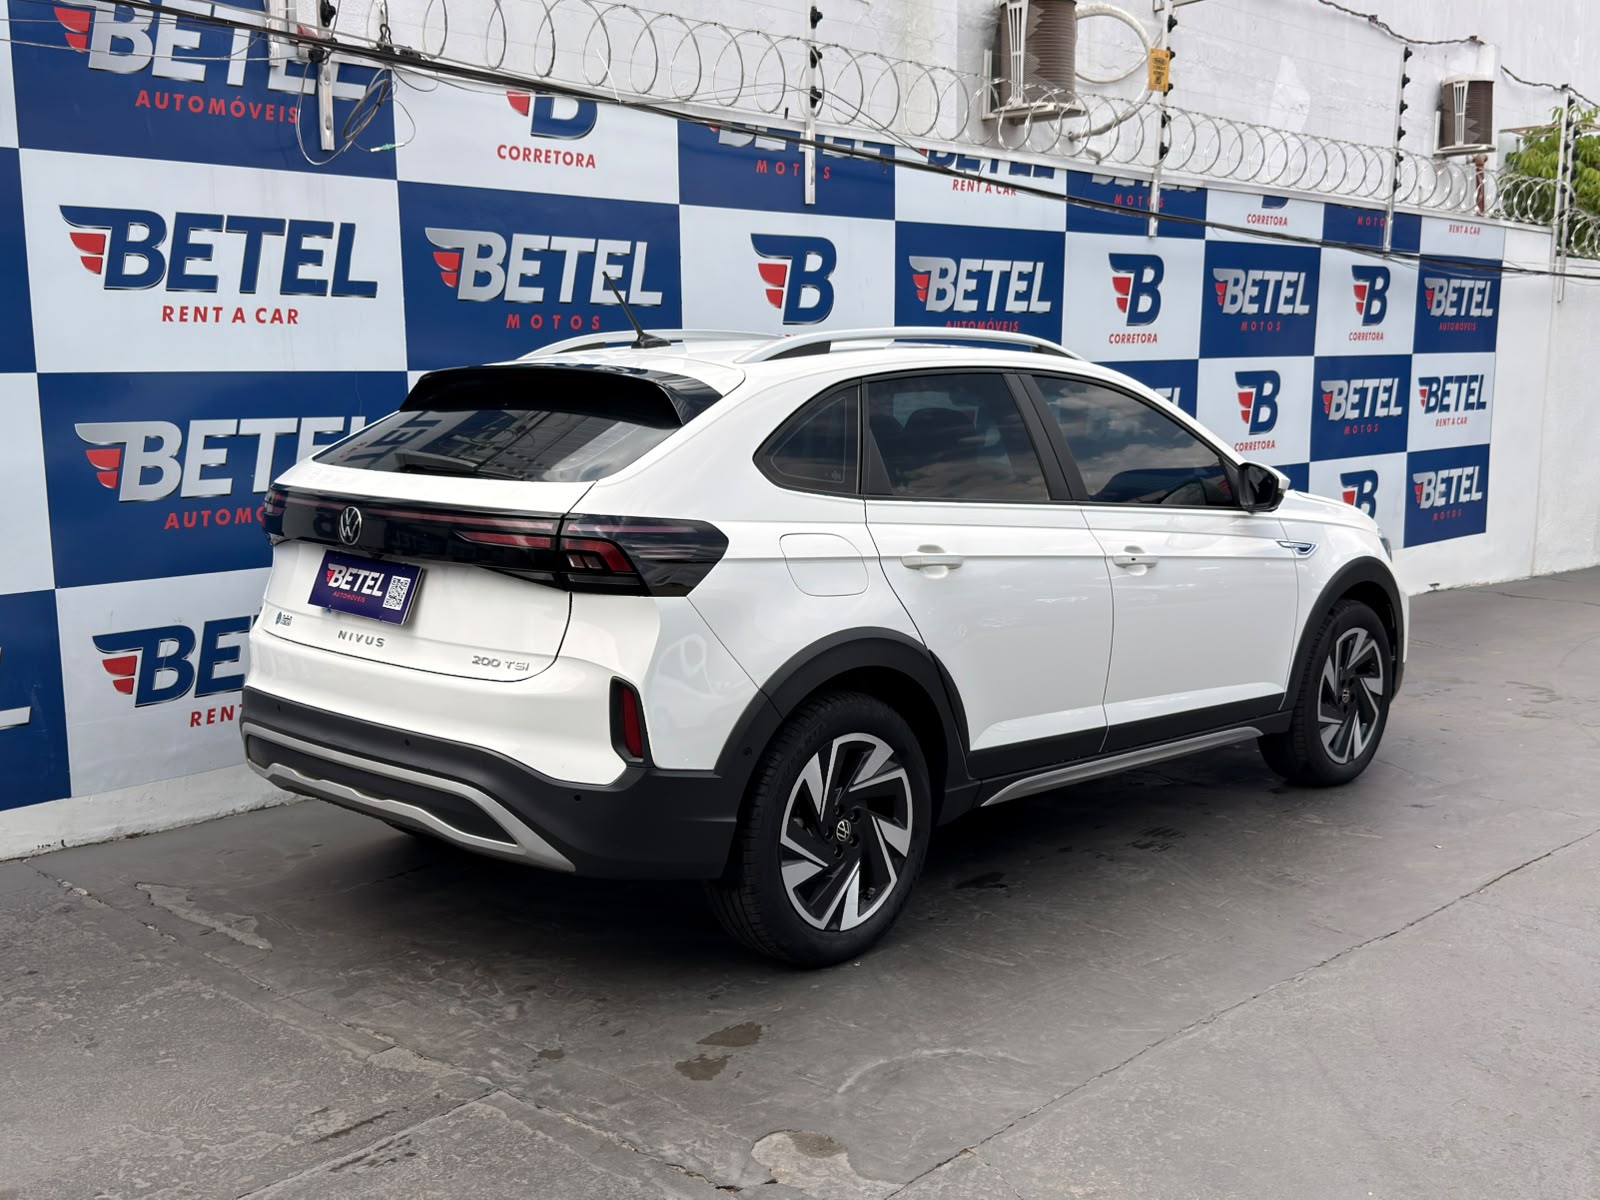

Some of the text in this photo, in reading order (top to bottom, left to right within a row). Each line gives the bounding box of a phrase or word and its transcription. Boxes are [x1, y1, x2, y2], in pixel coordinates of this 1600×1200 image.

[135, 89, 299, 124] AUTOMÓVEIS
[497, 144, 596, 169] CORRETORA
[756, 159, 831, 180] MOTS
[1246, 213, 1289, 227] CORRETORA
[1357, 215, 1386, 229] MOTO
[59, 204, 378, 299] BETEL
[424, 227, 663, 307] BETEL
[908, 255, 1052, 314] BETEL
[1212, 267, 1311, 315] BETEL
[1424, 277, 1494, 317] BETEL
[162, 305, 299, 325] RENT A CAR
[506, 314, 601, 330] MOTOS
[1241, 321, 1282, 332] MOTOS
[1349, 331, 1385, 342] CORRETORA
[1108, 332, 1158, 345] CORRETORA
[1321, 377, 1403, 422] BETEL
[1418, 374, 1487, 414] BETEL
[1344, 423, 1379, 435] MOTOS
[1234, 439, 1276, 453] CORRETORA
[1412, 465, 1483, 510] BETEL
[1432, 510, 1463, 521] MOTOS
[328, 563, 385, 597] BETEL
[333, 591, 367, 604] AUTOMÓVEIS
[337, 630, 386, 648] NIVUS
[472, 655, 530, 671] 200 TSI
